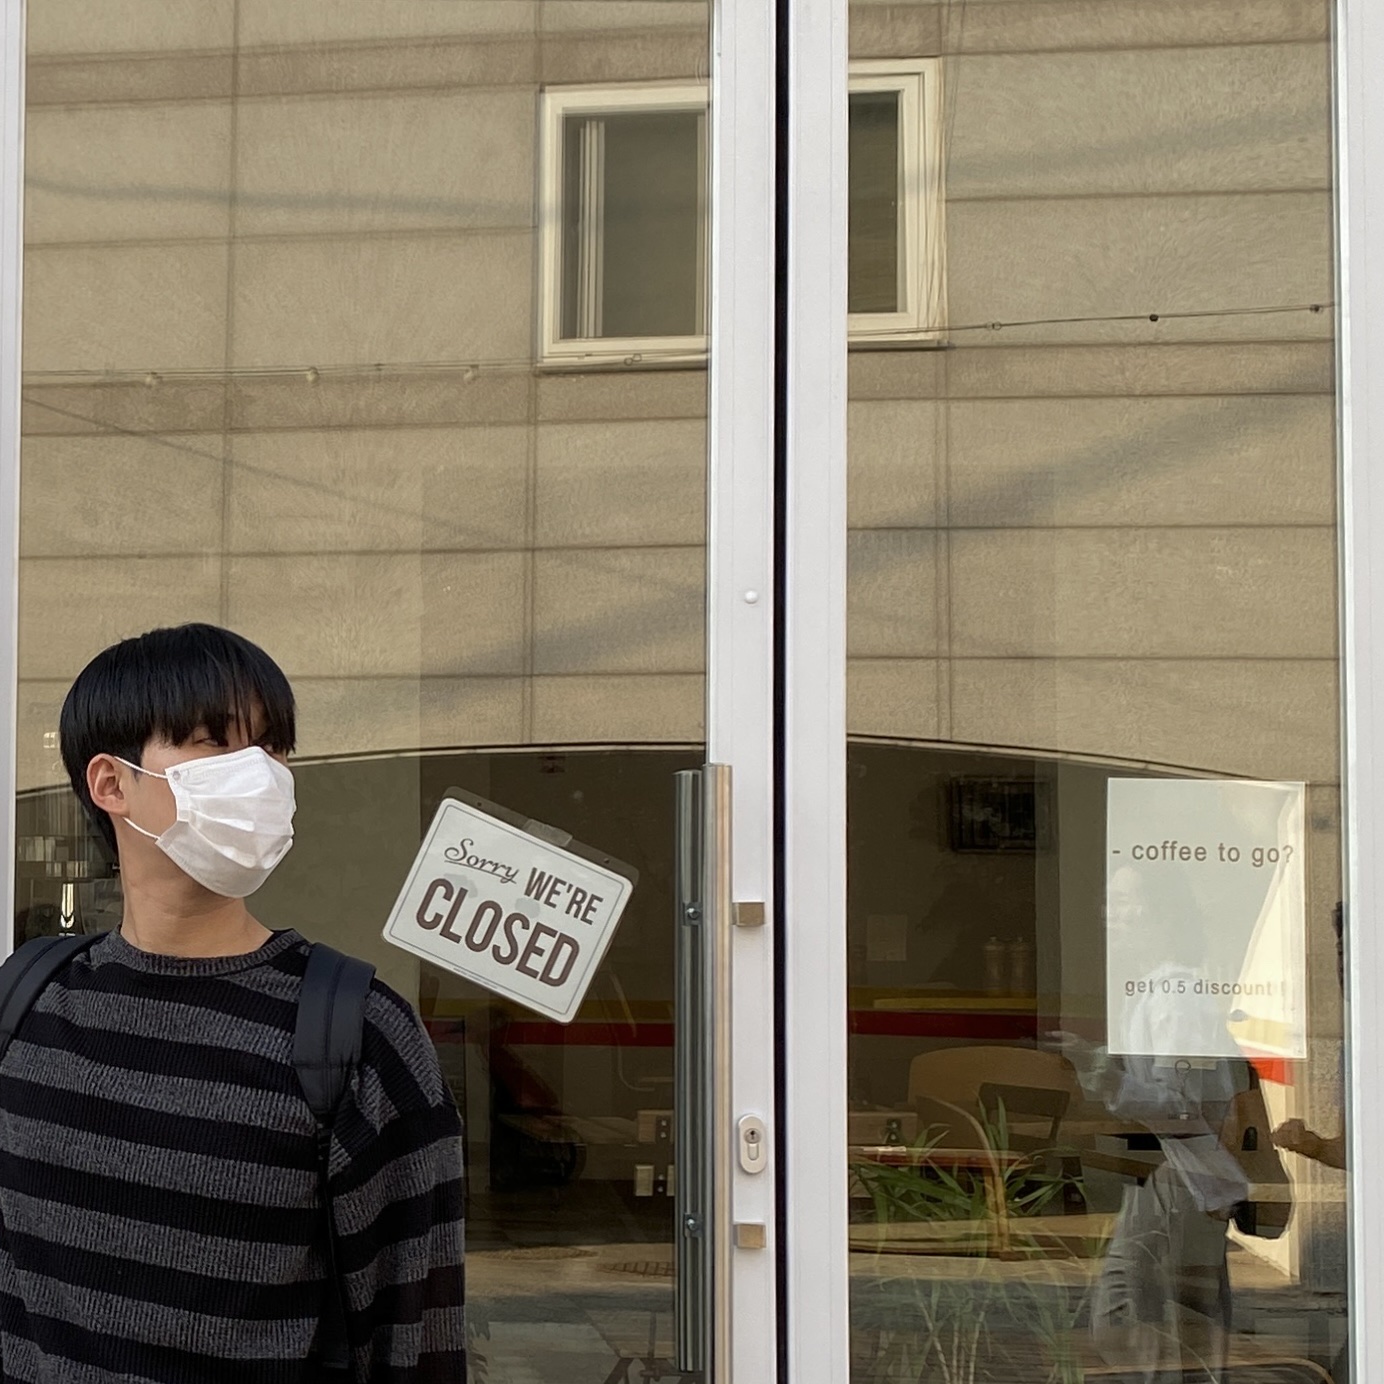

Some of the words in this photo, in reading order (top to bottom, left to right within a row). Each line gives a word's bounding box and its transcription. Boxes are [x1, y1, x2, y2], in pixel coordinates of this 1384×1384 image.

[444, 838, 520, 885] Sorry
[524, 867, 604, 926] WE'RE
[1131, 840, 1207, 863] coffee
[1218, 842, 1241, 863] to
[1251, 845, 1294, 868] go?
[415, 878, 580, 988] CLOSED
[1125, 980, 1154, 997] get
[1162, 979, 1186, 994] 0.5
[1193, 979, 1273, 995] discount
